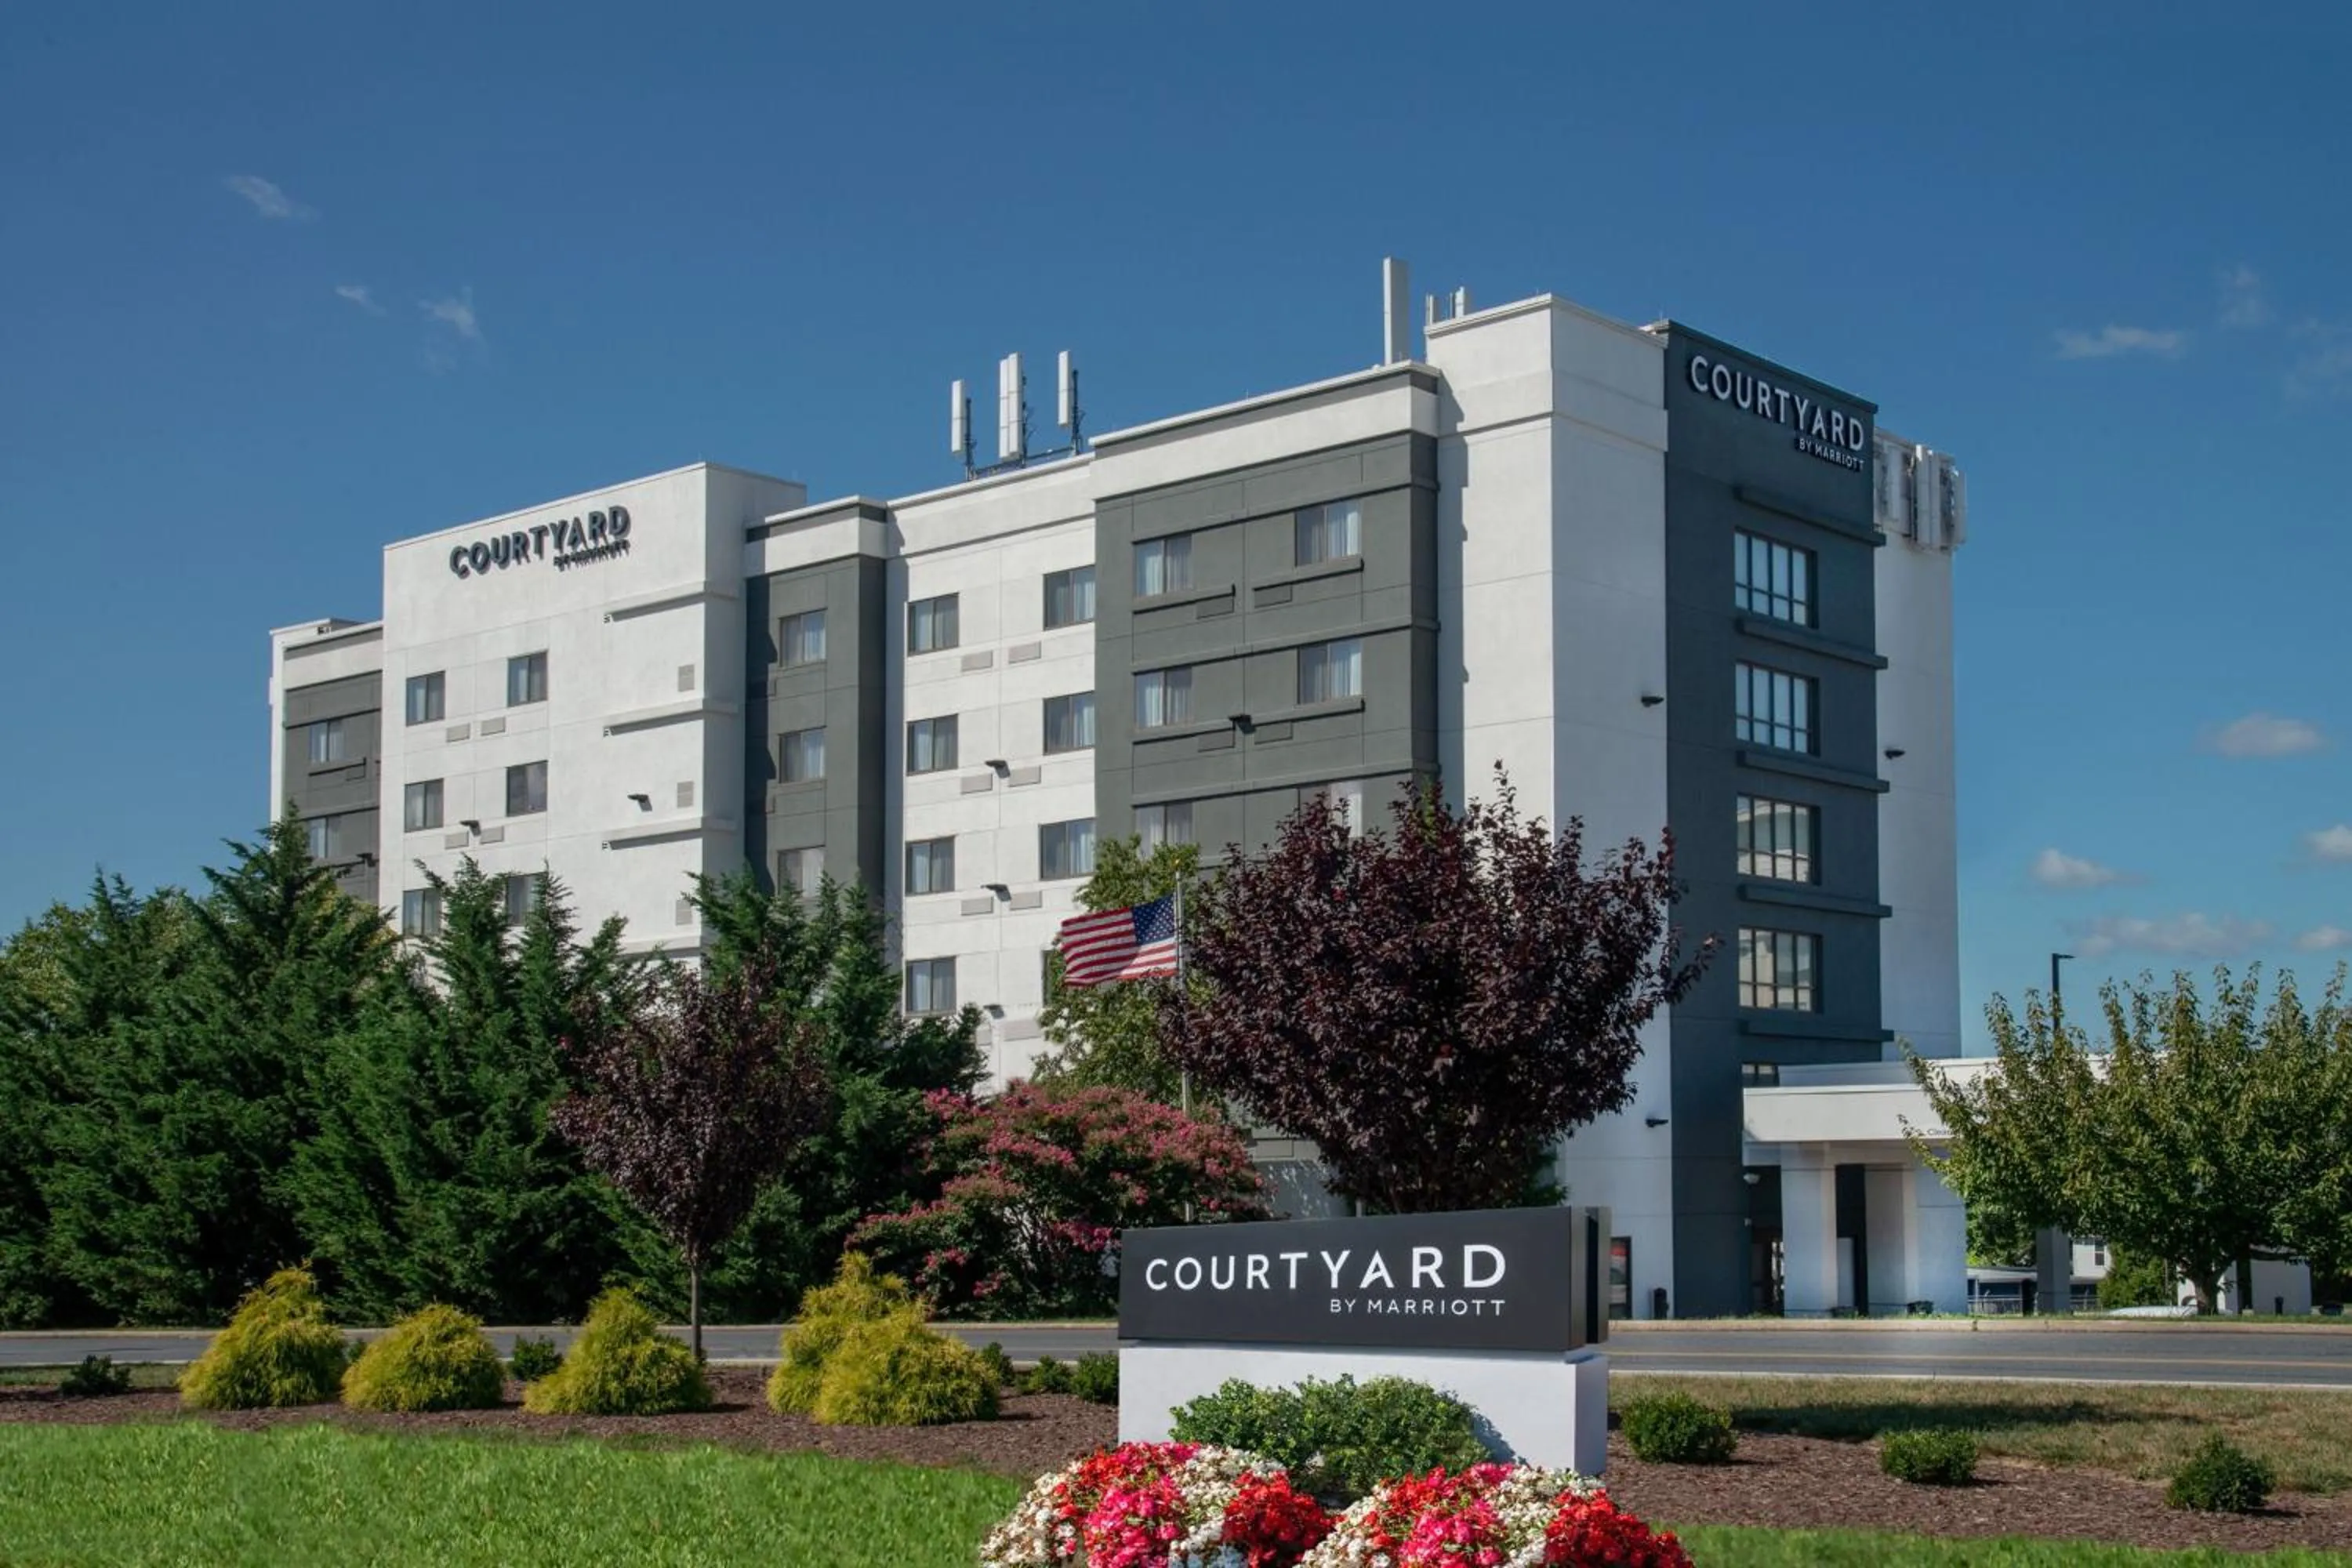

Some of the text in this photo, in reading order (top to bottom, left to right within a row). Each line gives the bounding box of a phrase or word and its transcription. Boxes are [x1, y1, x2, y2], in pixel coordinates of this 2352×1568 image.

[1691, 354, 1864, 452] COURTYARD
[1799, 437, 1864, 470] BY MARRIOTT
[449, 505, 631, 579] COURTYARD
[1145, 1244, 1507, 1290] COURTYARD
[1330, 1298, 1507, 1316] BY MARRIOTT
